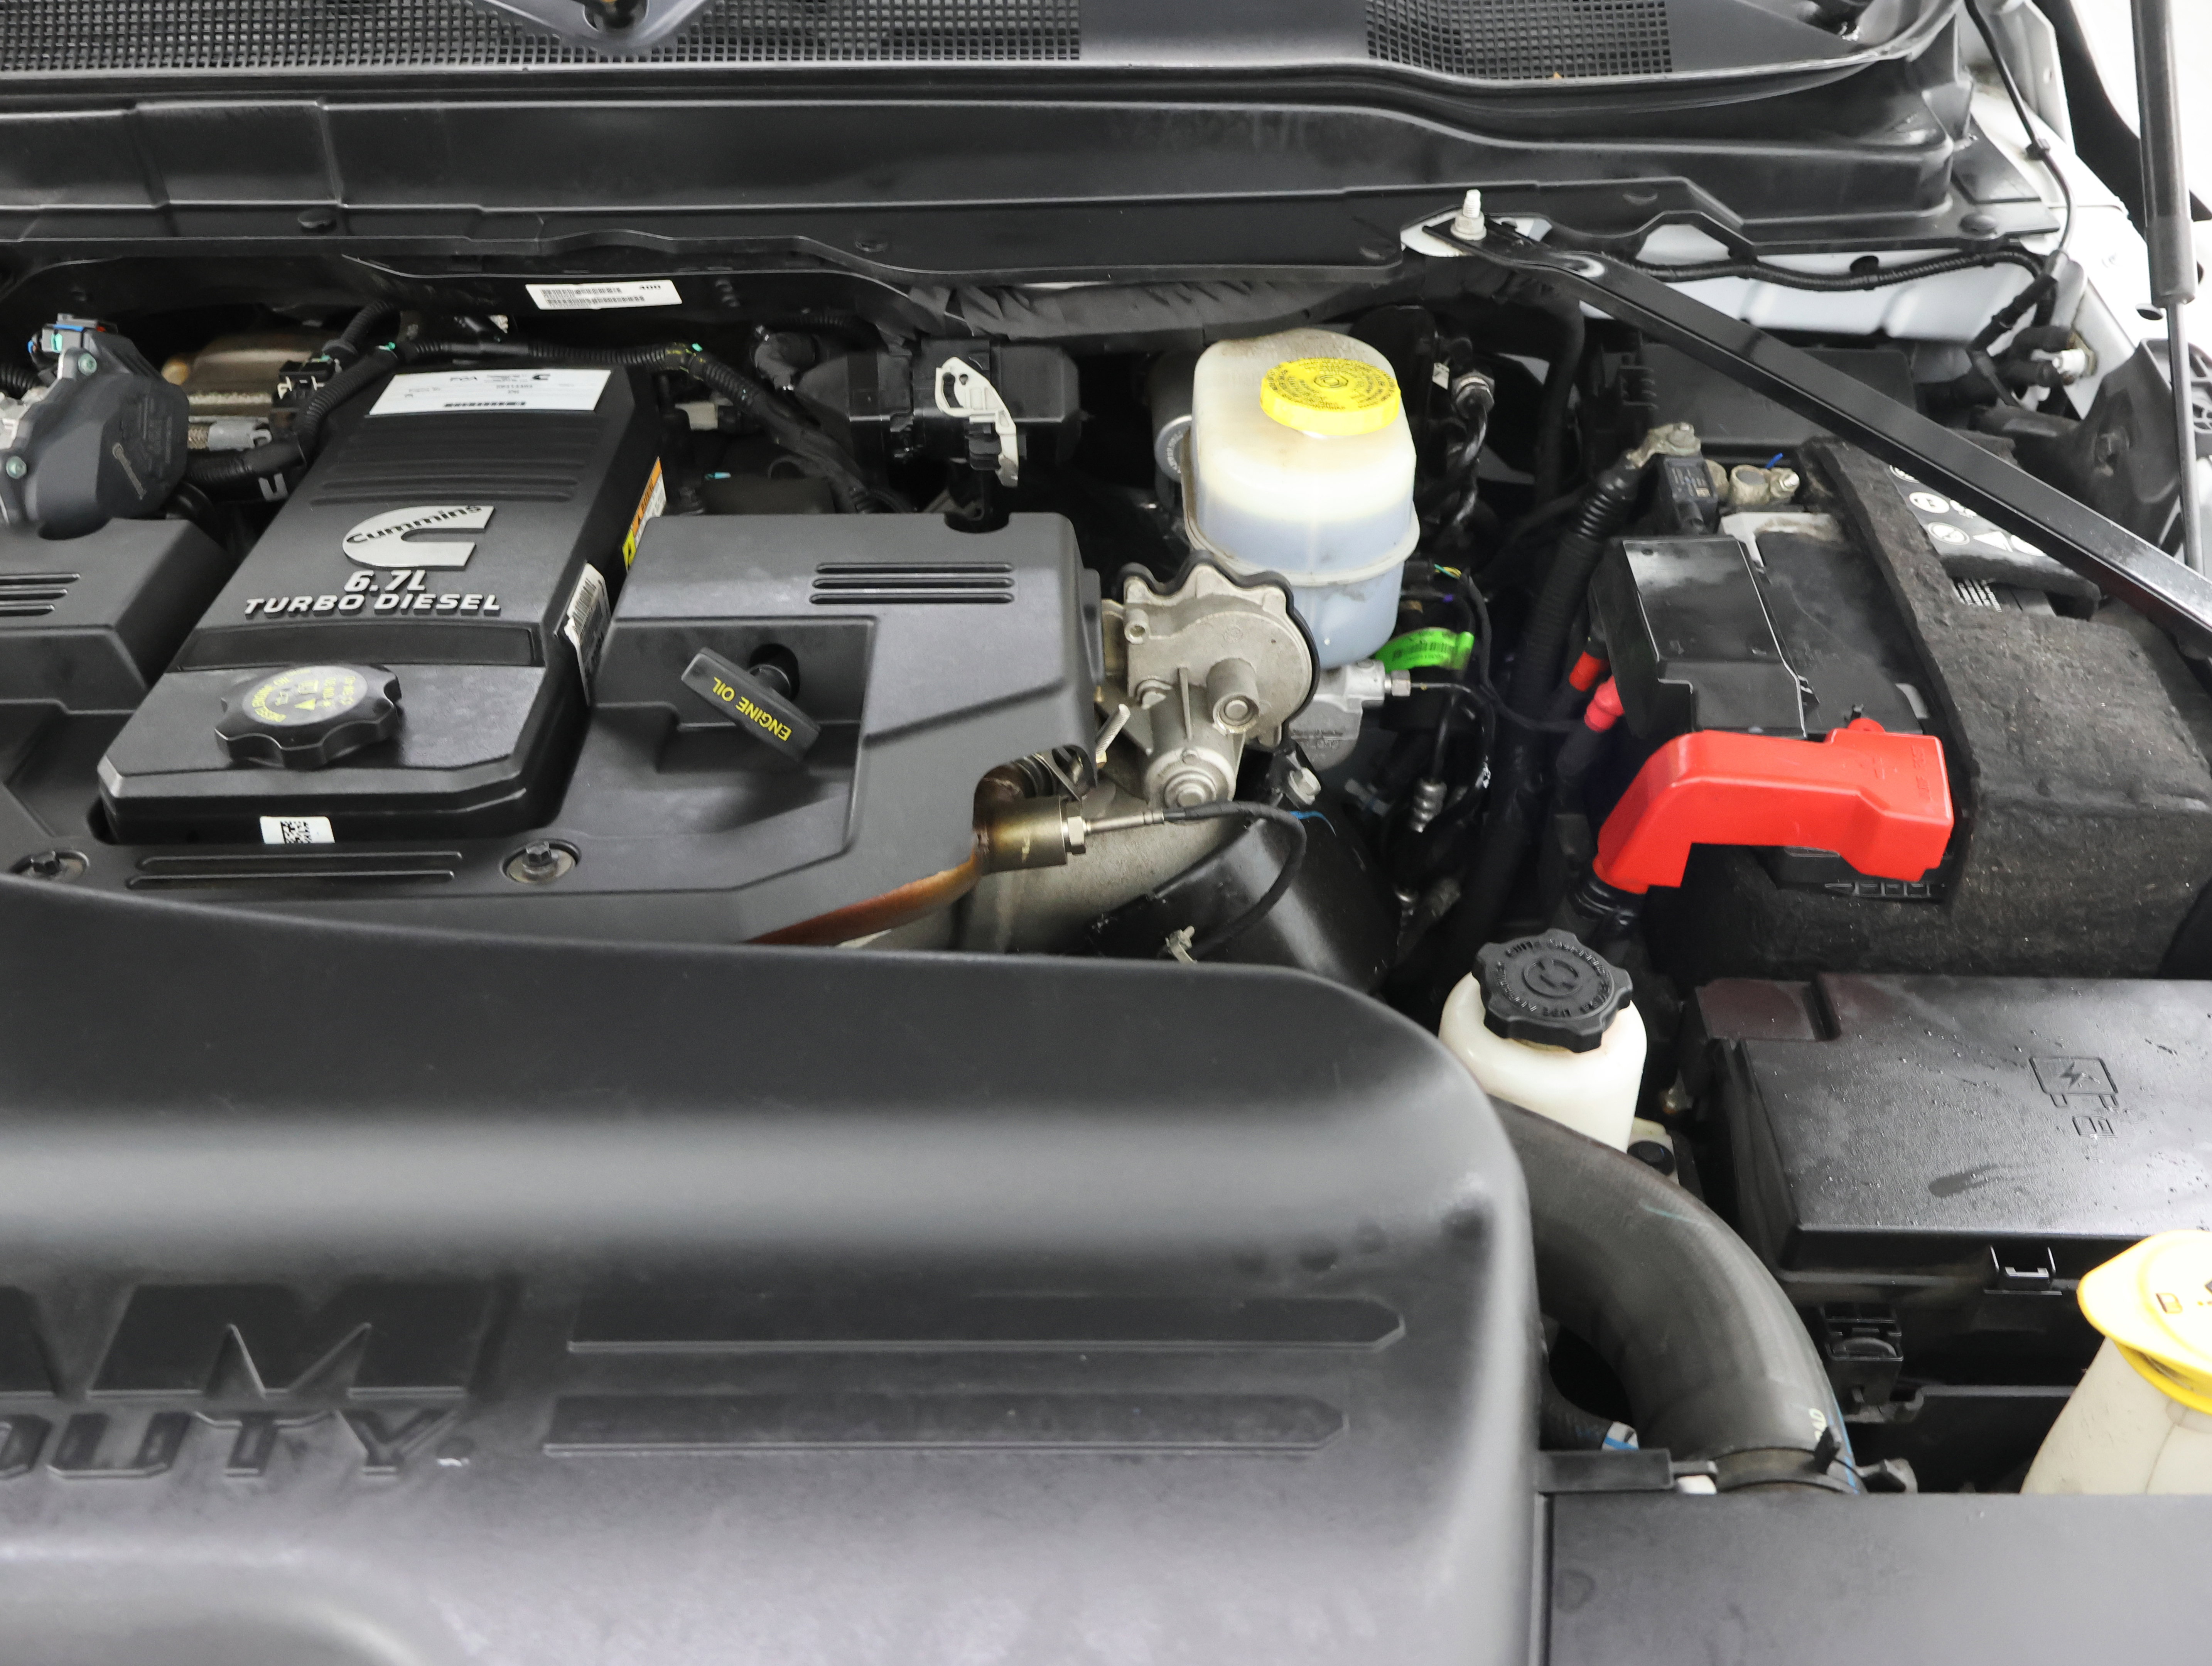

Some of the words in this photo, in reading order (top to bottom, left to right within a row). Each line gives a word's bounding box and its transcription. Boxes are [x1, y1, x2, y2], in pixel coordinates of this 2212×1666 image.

[346, 504, 482, 544] Cummins
[344, 569, 427, 592] 6.7L
[245, 593, 366, 615] TURBO
[374, 593, 501, 613] DIESEL
[711, 676, 736, 702] OIL
[735, 696, 792, 741] ENGINE
